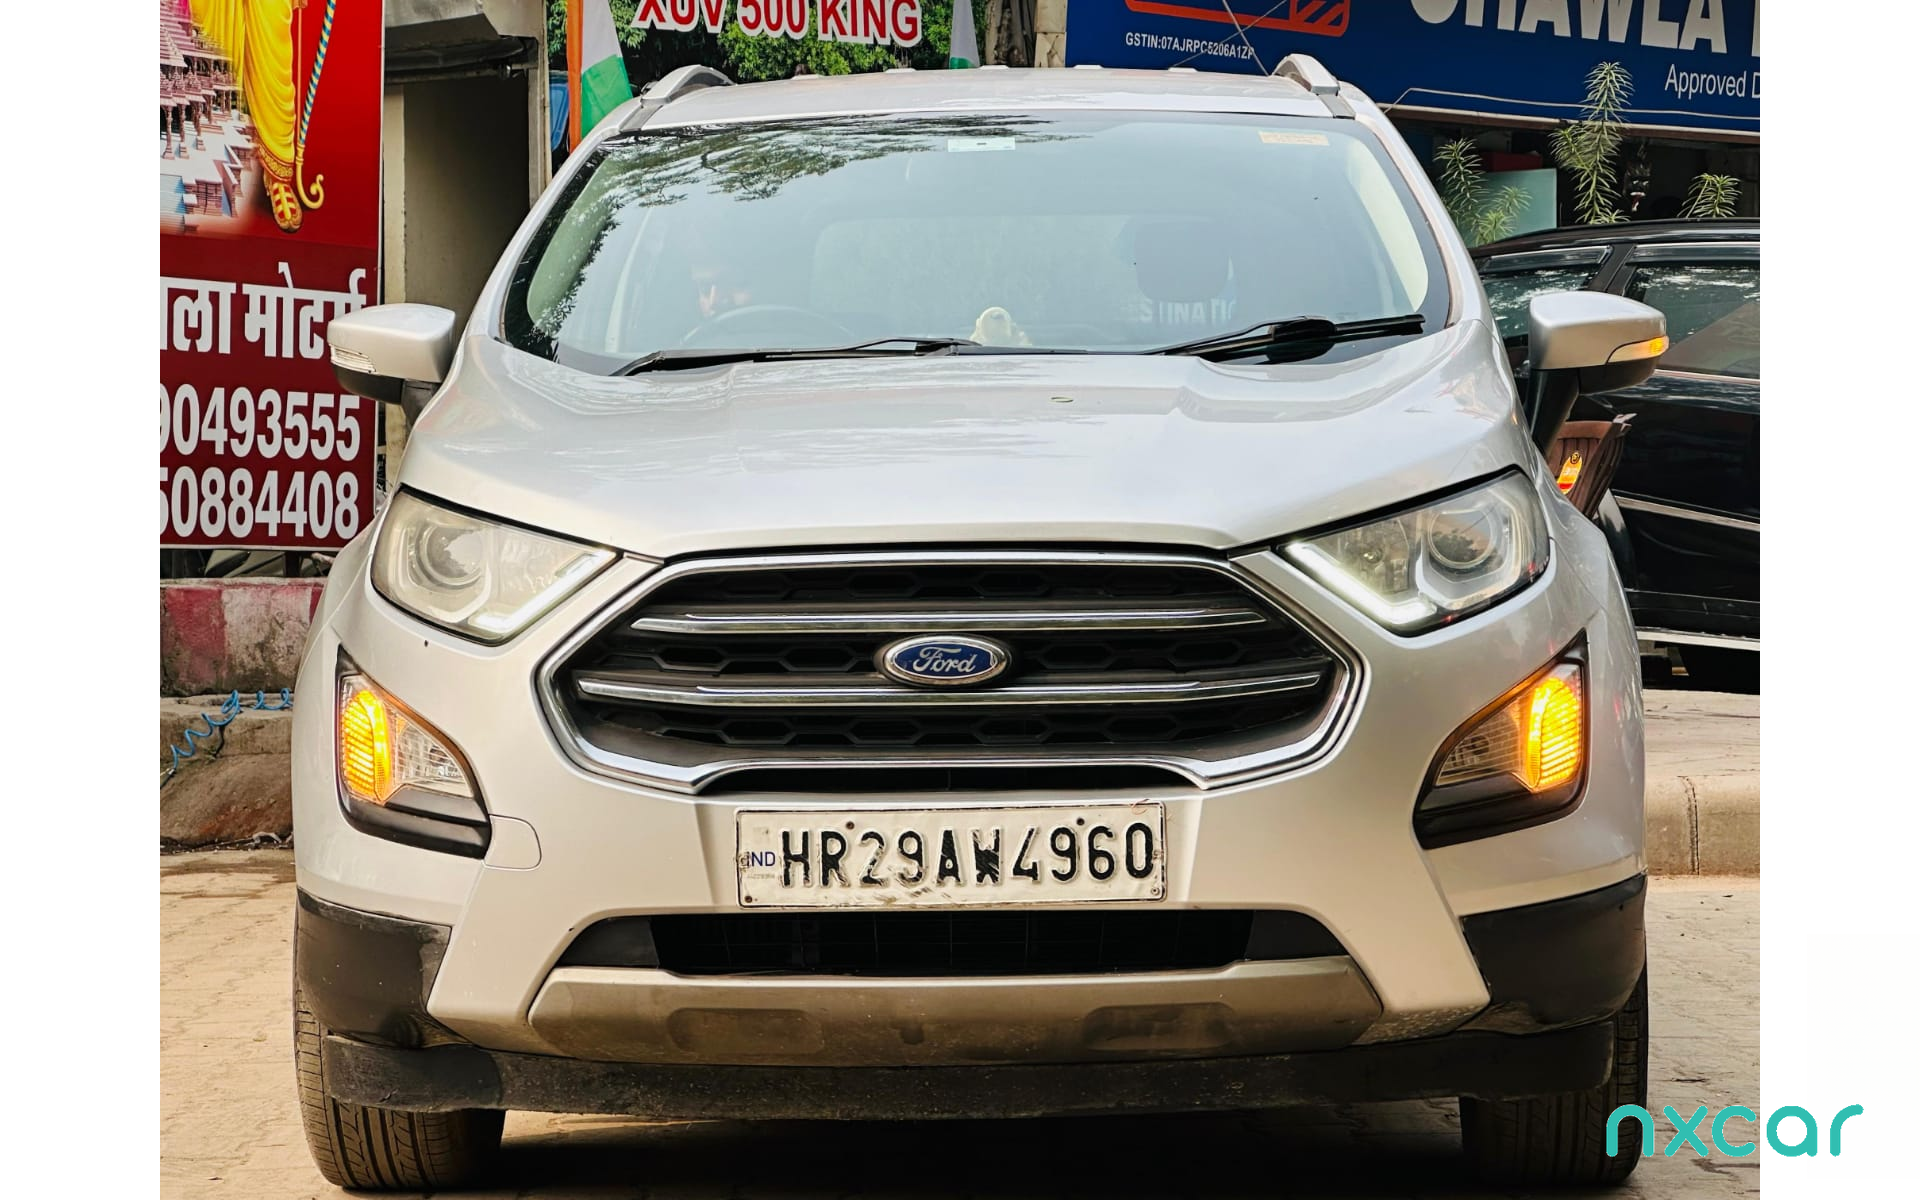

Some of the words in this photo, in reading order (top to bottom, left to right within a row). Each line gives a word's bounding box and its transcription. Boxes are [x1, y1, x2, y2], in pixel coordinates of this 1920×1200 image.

[741, 0, 807, 34] 500
[822, 0, 918, 41] KING
[1664, 63, 1747, 100] Approved
[912, 646, 978, 673] Ford
[746, 851, 776, 868] IND
[780, 821, 1155, 889] HR29AW4960
